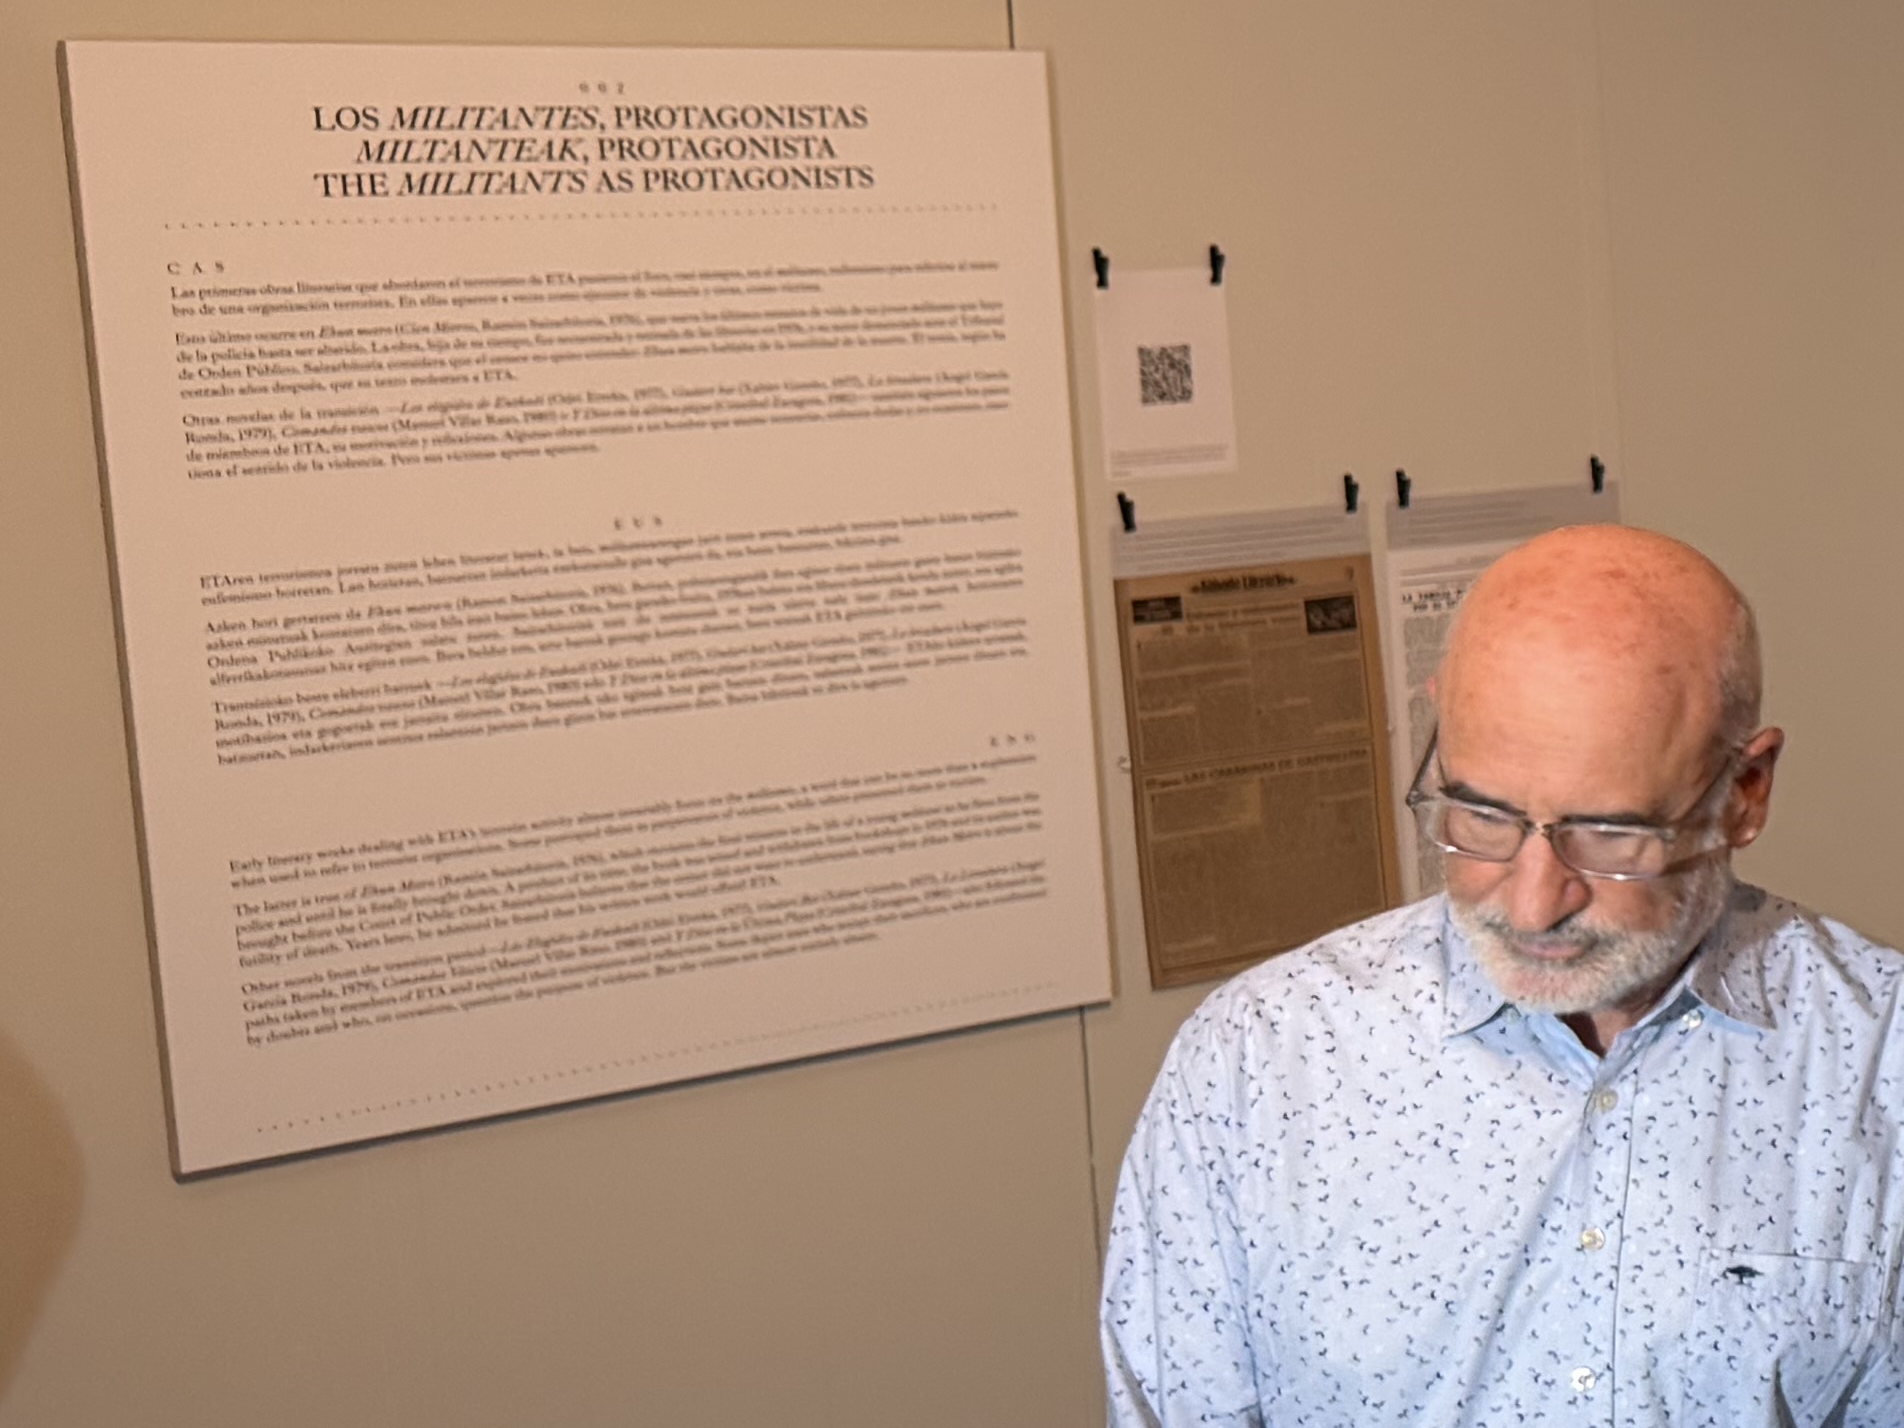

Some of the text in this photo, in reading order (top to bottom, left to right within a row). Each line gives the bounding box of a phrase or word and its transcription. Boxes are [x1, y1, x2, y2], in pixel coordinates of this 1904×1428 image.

[312, 105, 868, 132] LOS MILITANTES, PROTAGONISTAS
[598, 136, 838, 161] PROTAGONISTA
[313, 165, 875, 197] THE MILITANTS AS PROTAGONISTS
